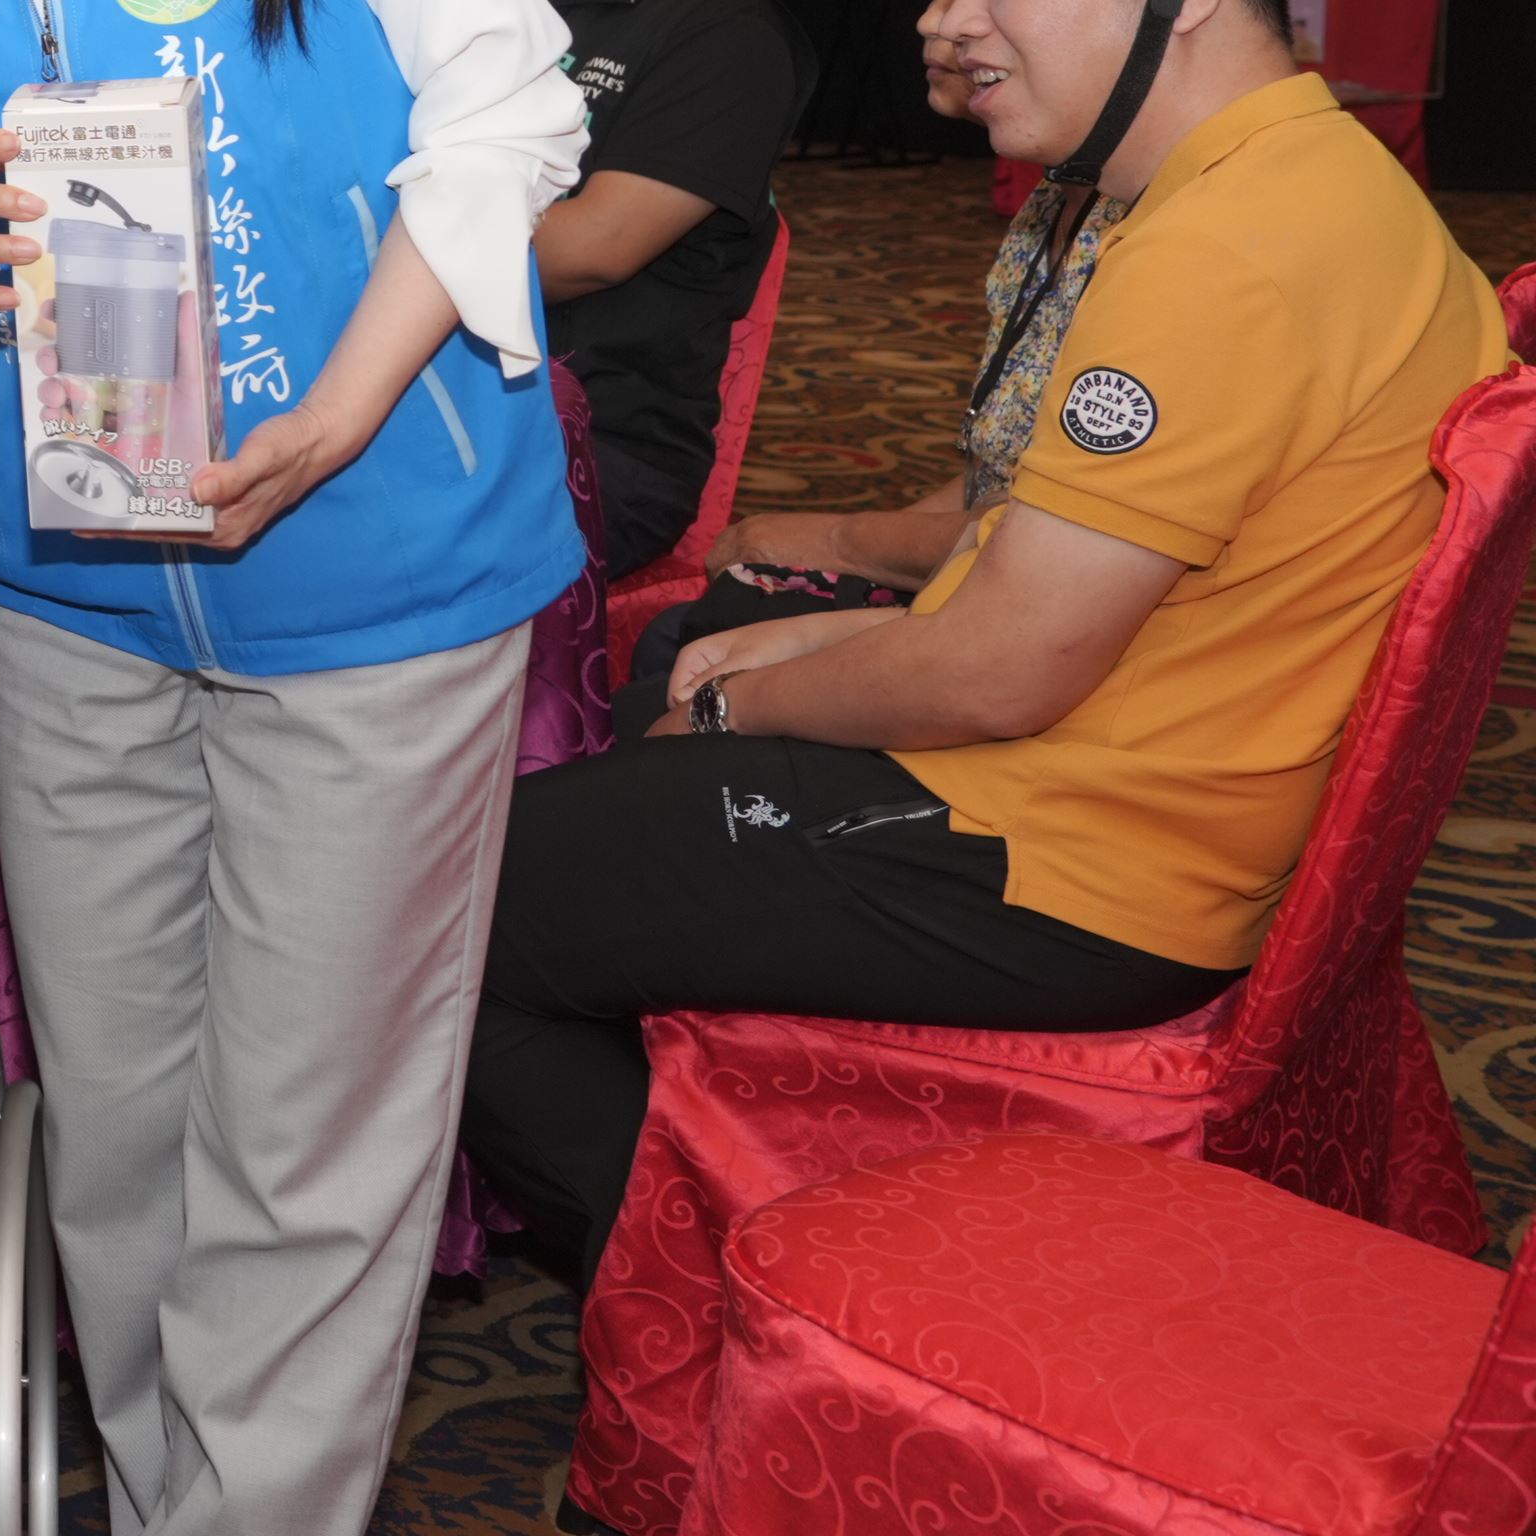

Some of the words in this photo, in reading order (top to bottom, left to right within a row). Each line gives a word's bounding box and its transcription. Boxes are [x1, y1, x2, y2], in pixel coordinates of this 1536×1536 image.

[583, 57, 626, 75] IWAN
[576, 70, 625, 92] OPLE'S
[16, 125, 70, 145] Fujitek
[72, 124, 137, 141] 富士電通
[17, 145, 173, 163] 隨行杯無線充電果汁機
[1070, 395, 1081, 405] 19
[1083, 400, 1126, 425] STYLE
[1128, 418, 1144, 431] 93
[1068, 417, 1126, 446] ATHLETIC
[1086, 417, 1112, 431] DEPT
[139, 459, 182, 475] USB
